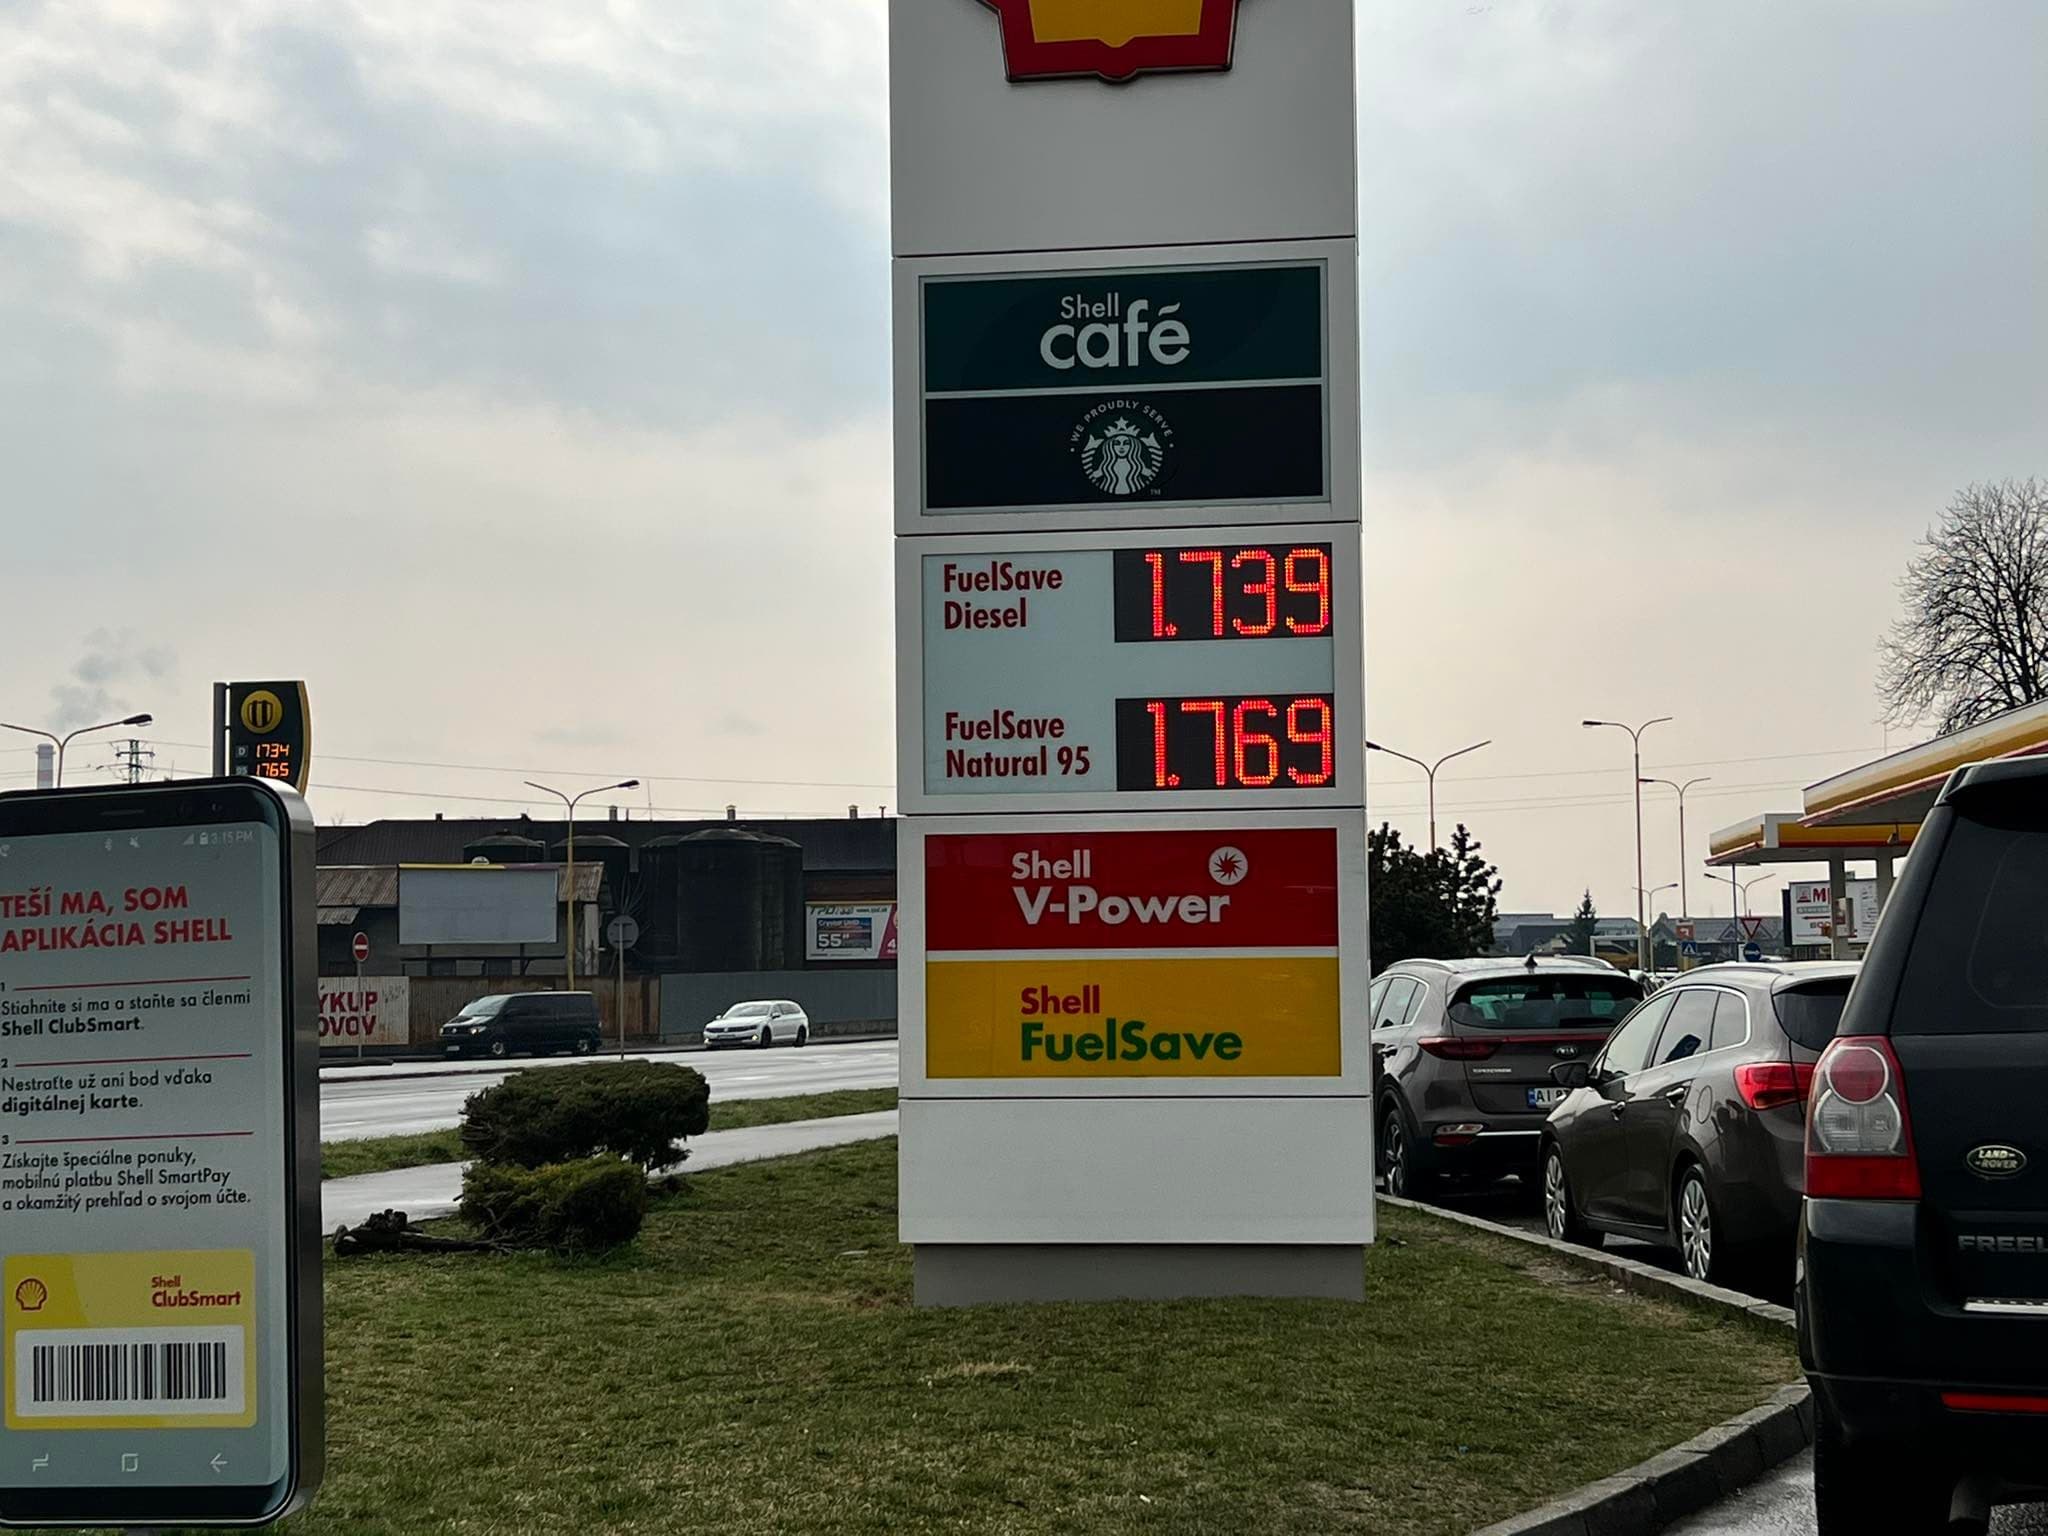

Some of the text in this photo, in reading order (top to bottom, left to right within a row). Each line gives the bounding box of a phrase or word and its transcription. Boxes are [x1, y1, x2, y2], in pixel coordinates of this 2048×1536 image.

[1061, 292, 1120, 319] Shell
[1040, 299, 1191, 369] café
[1071, 400, 1173, 441] WE PROUDLY SERVE
[944, 562, 1063, 592] FuelSave
[1145, 548, 1329, 637] 1.739
[944, 597, 1027, 629] Diesel
[945, 710, 1064, 740] FuelSave
[256, 743, 290, 758] 1734
[1147, 698, 1331, 787] 1.769
[256, 762, 289, 777] 1765
[946, 745, 1090, 778] Natural 95
[235, 831, 253, 842] PM
[1012, 849, 1090, 879] Shell
[0, 886, 188, 918] TEŠÍ MA, SOM
[1012, 885, 1230, 925] V-Power
[1, 918, 232, 952] APLIKÁCIA SHELL
[2, 989, 250, 1016] Stiahnite si ma a staňte sa členmi
[1021, 984, 1100, 1015] Shell
[2, 1016, 145, 1036] Shell ClubSmart.
[1021, 1018, 1242, 1060] FuelSave
[1, 1059, 8, 1068] 2
[2, 1068, 212, 1092] Nestraťte už ani bod vďaka
[2, 1093, 144, 1116] digitálnej karte.
[2, 1135, 9, 1144] 3
[2, 1146, 196, 1172] Získajte špeciálne ponuky,
[1978, 1150, 2008, 1159] LAND
[1981, 1159, 2018, 1169] ROVER
[2, 1167, 231, 1192] mobilnú platbu Shell SmartPay
[2, 1188, 251, 1213] a okamžitý prehľad o svojom účte.
[151, 1274, 181, 1288] Shell
[152, 1289, 241, 1307] ClubSmart
